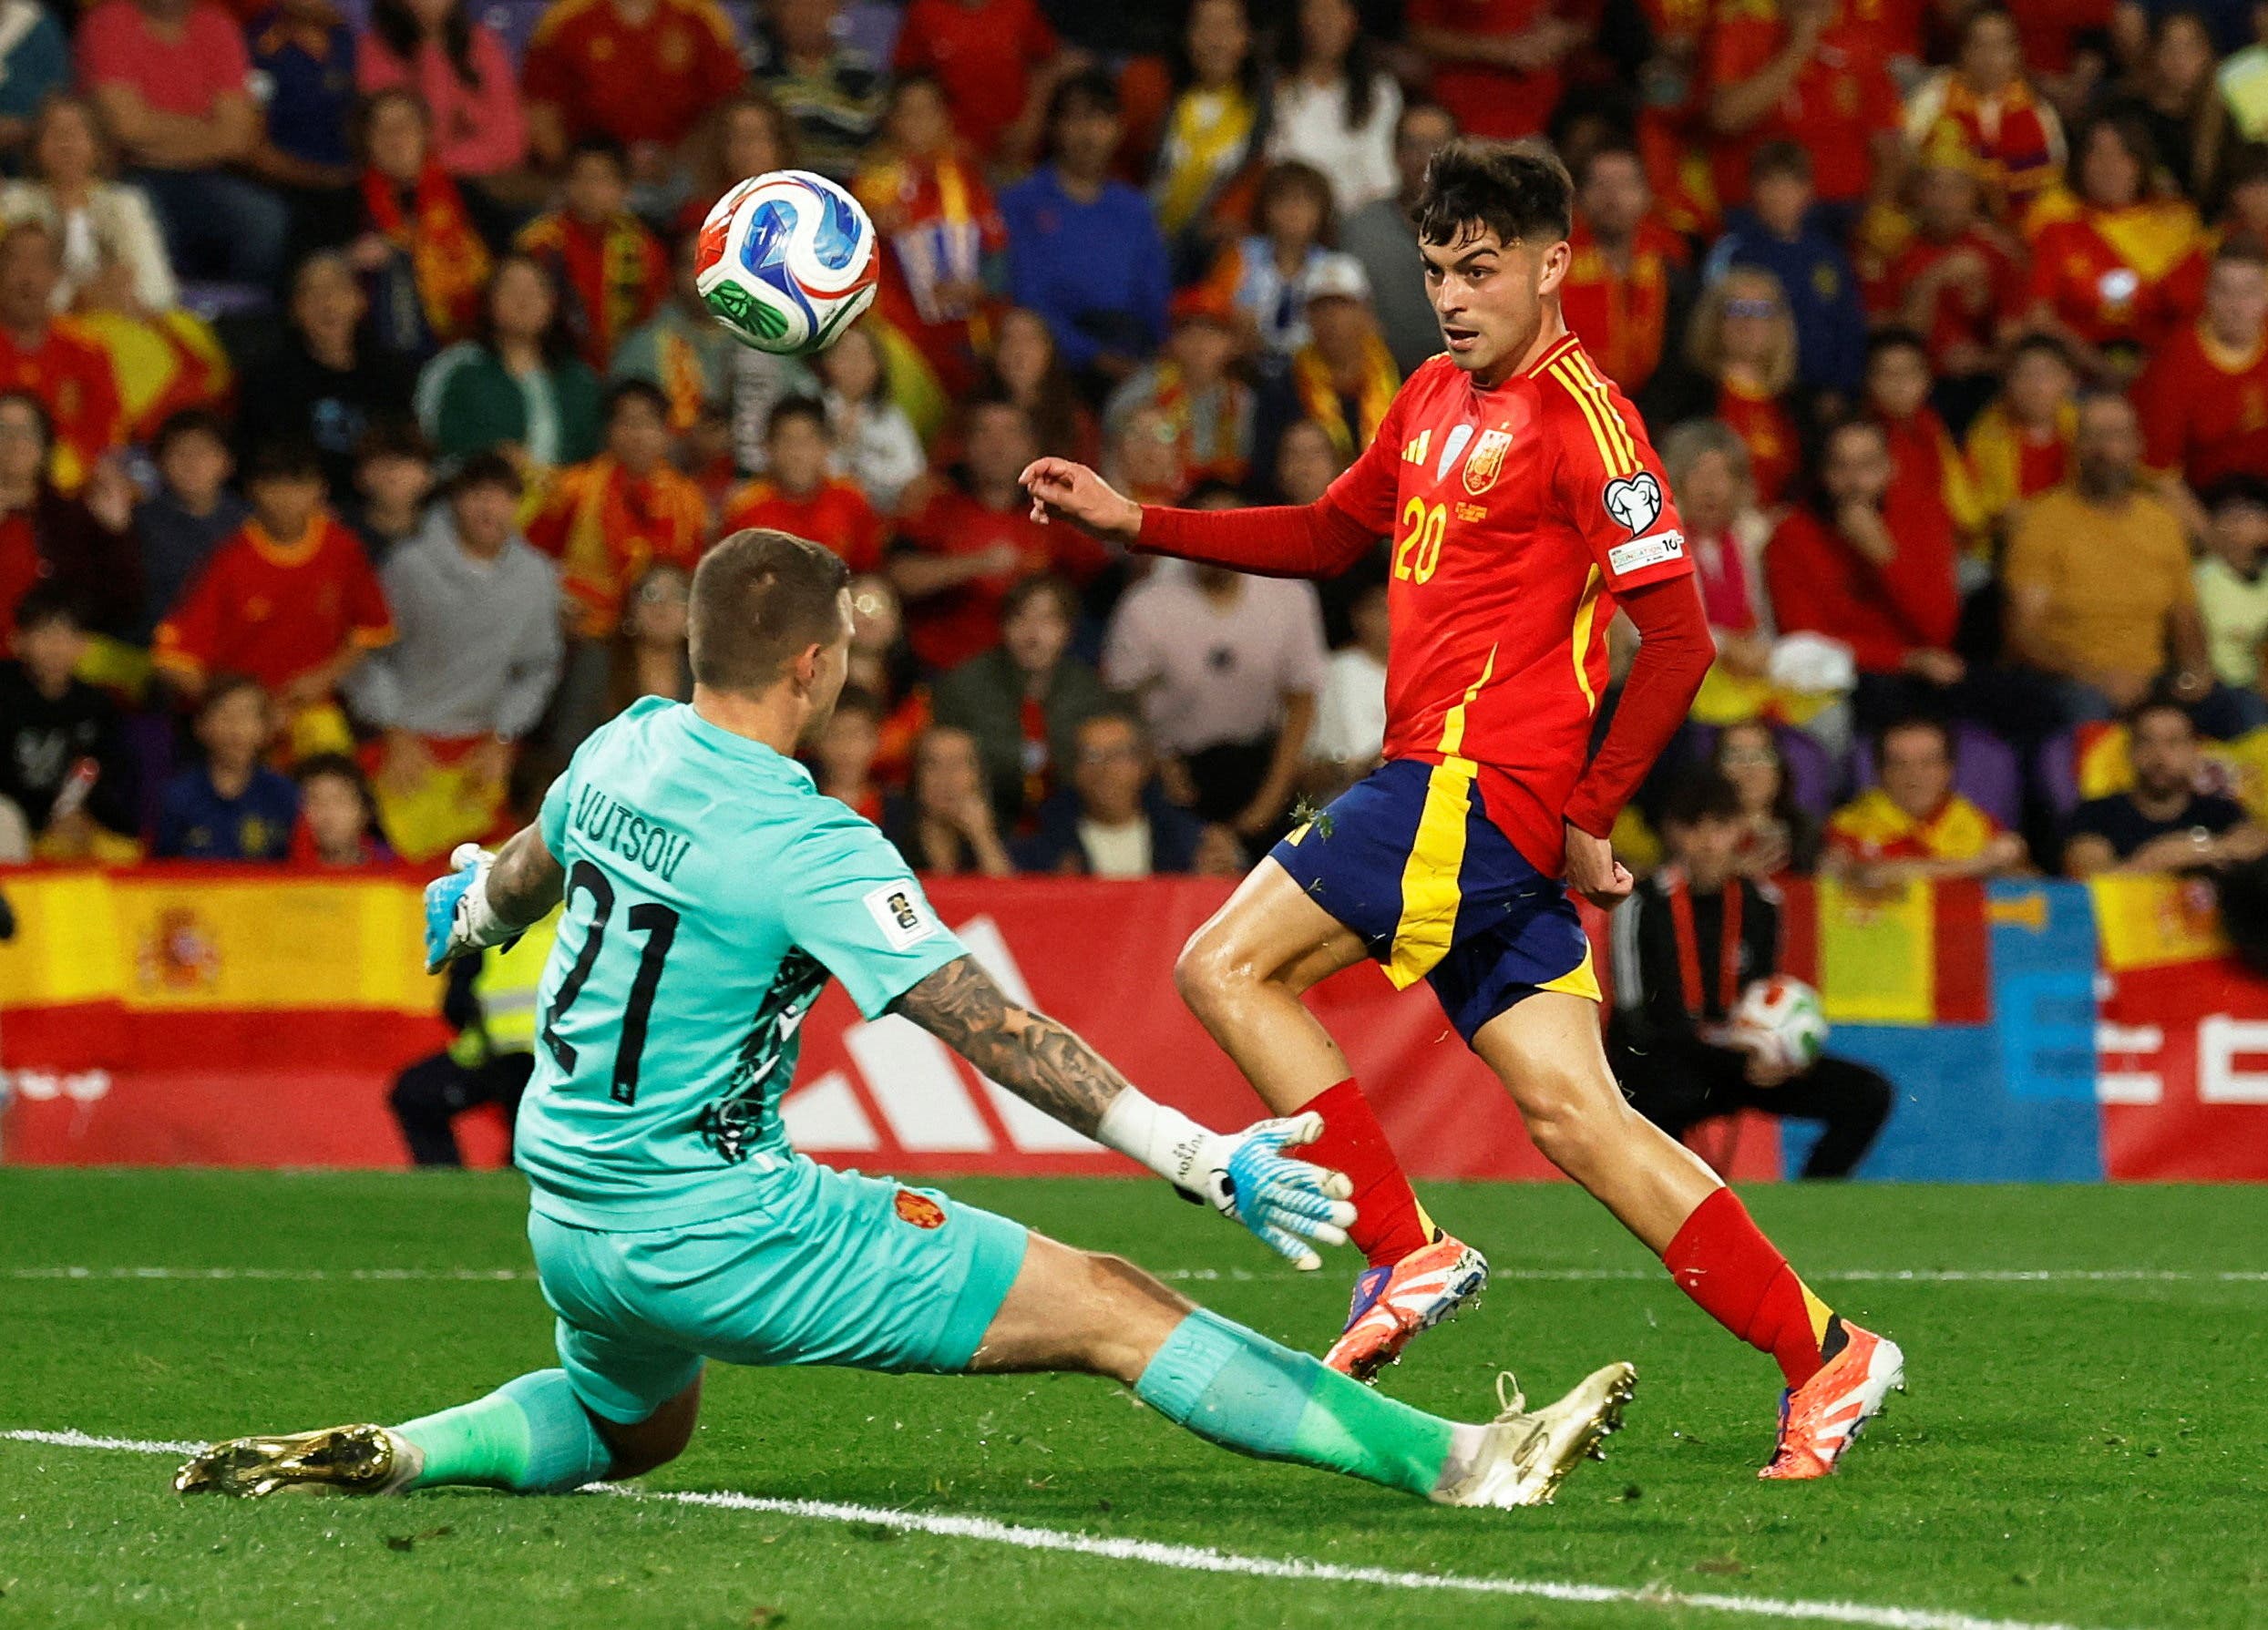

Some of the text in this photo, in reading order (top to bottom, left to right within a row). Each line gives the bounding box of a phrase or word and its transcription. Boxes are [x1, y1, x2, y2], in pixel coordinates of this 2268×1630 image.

[1394, 496, 1447, 585] 20
[575, 783, 691, 883] VUTSOV
[542, 858, 680, 1106] 21
